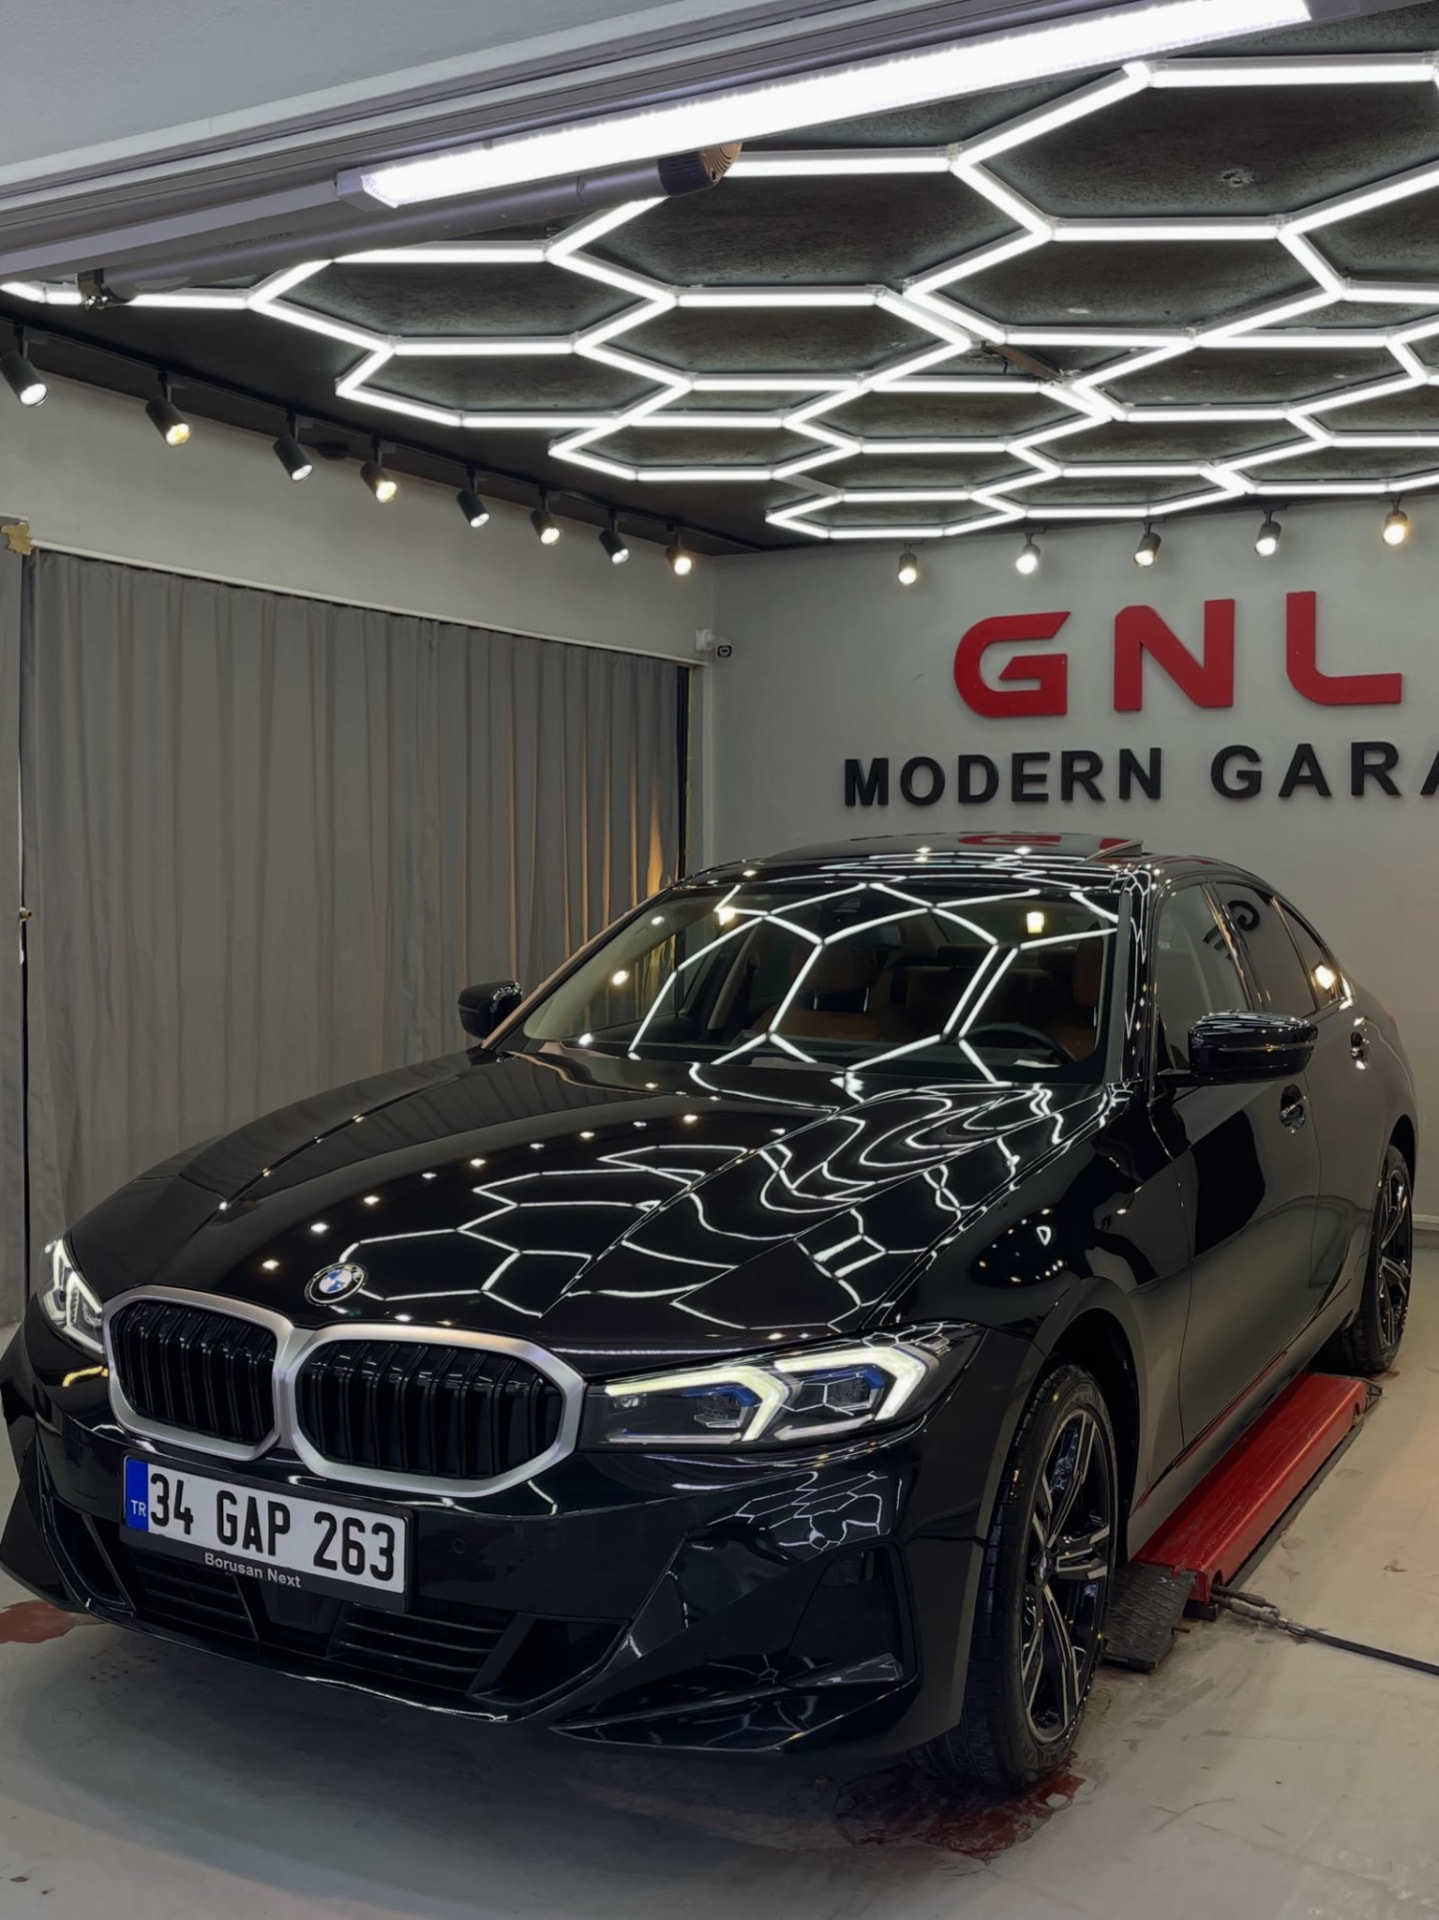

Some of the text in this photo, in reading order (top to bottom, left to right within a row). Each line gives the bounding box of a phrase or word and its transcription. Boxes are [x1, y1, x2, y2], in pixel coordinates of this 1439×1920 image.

[954, 590, 1403, 719] GNL
[844, 747, 1163, 806] MODERN
[130, 1472, 396, 1582] TR 34 GAP 263
[204, 1552, 302, 1588] Borusan Next
